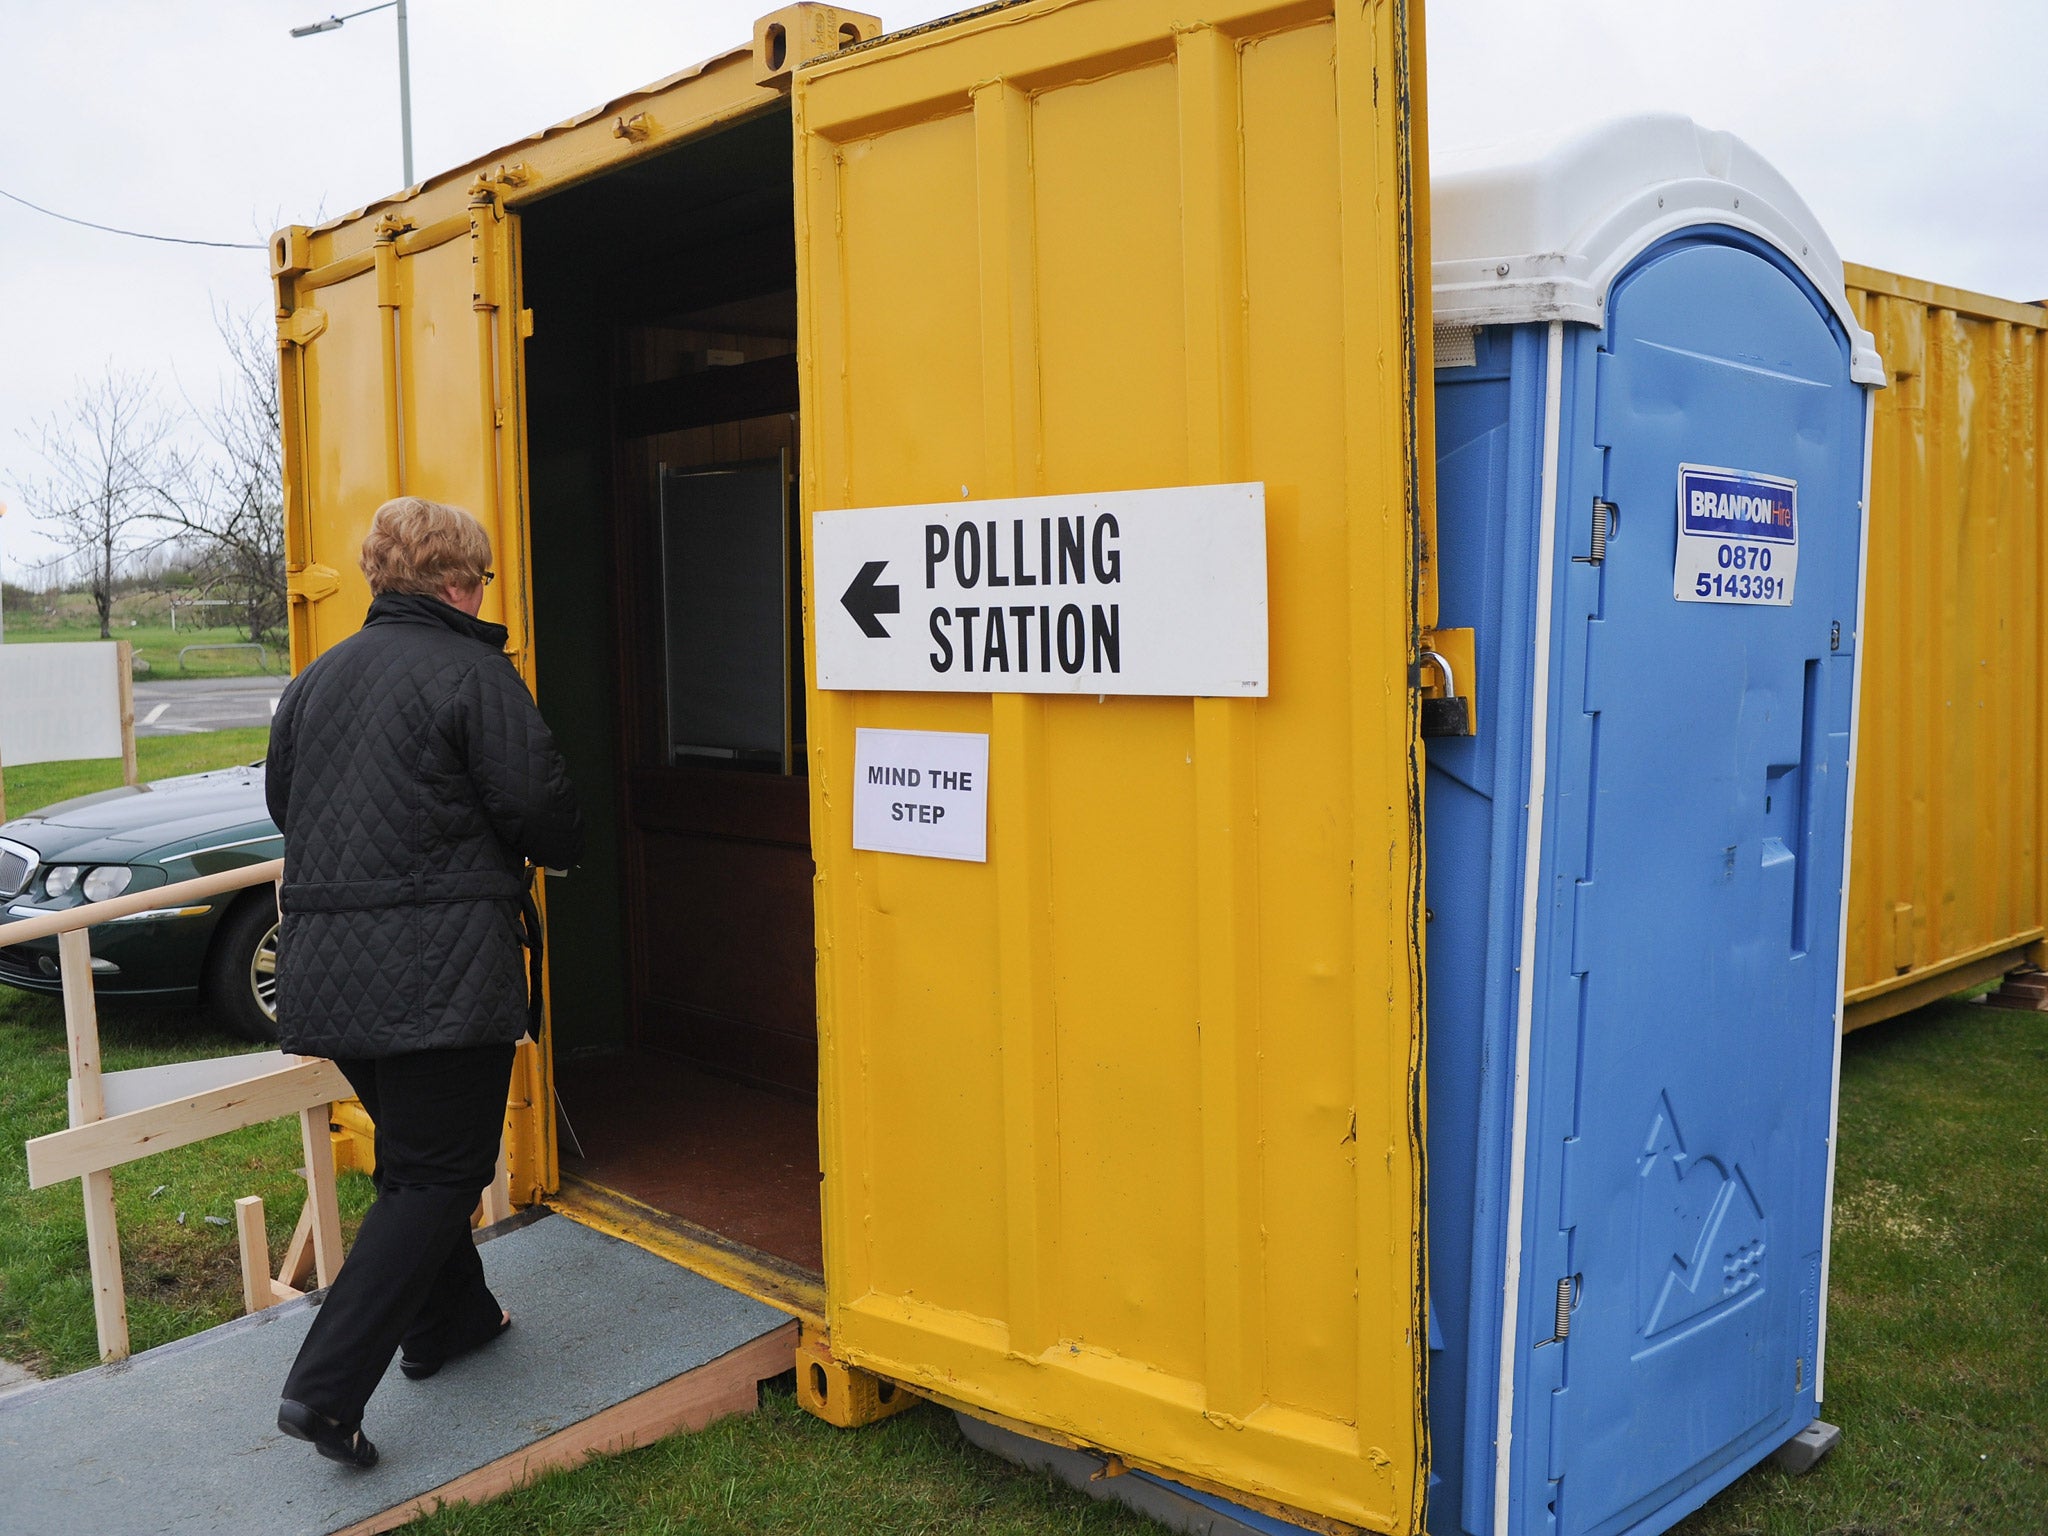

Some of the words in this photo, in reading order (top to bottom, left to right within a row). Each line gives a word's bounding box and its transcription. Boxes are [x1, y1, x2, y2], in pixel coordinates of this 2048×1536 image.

[925, 512, 1121, 589] POLLING
[1717, 544, 1772, 572] 0870
[1695, 572, 1784, 600] 5143391
[929, 603, 1121, 675] STATION
[868, 765, 921, 787] MIND
[928, 769, 972, 792] THE
[891, 802, 945, 825] STEP
